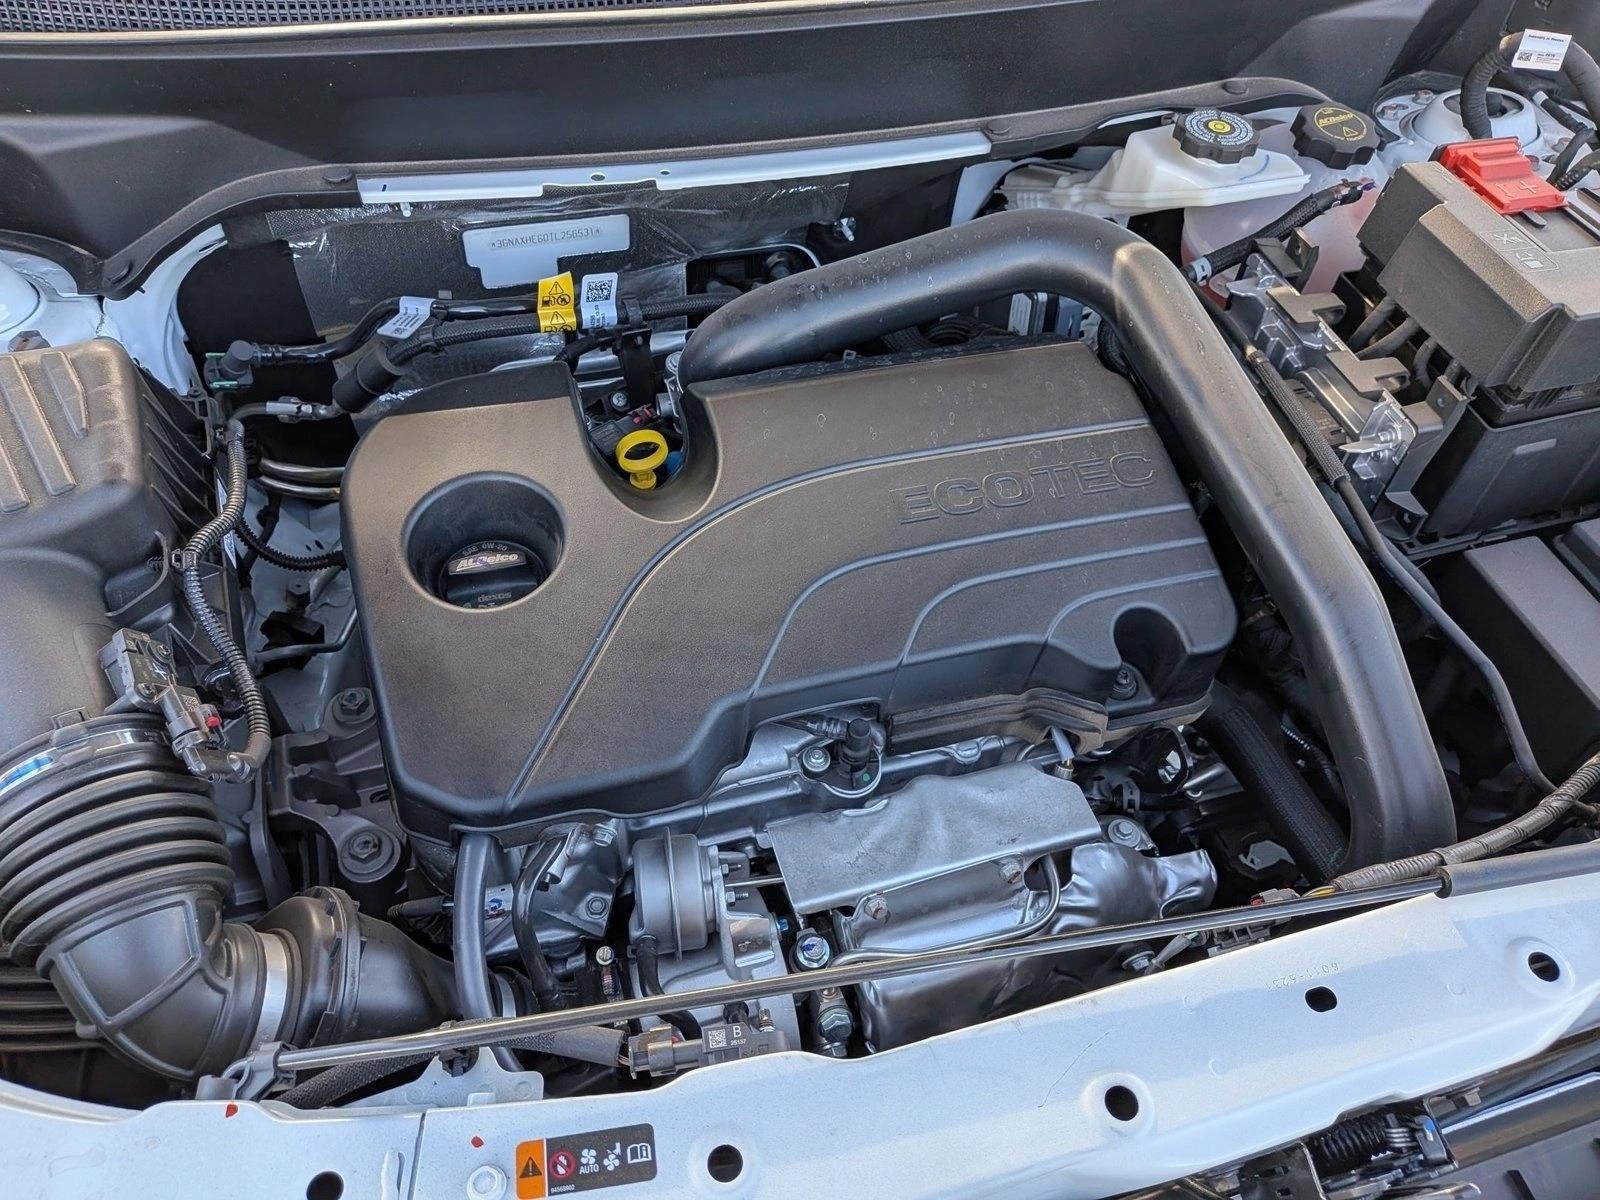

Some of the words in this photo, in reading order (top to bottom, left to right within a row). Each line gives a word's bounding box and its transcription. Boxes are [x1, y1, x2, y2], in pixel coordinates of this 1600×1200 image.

[889, 452, 1155, 525] ECOTEC
[462, 546, 479, 557] SAE
[481, 542, 508, 551] 0W-20
[732, 1025, 742, 1038] B
[730, 1038, 747, 1046] 25137
[579, 1163, 600, 1175] AUTO
